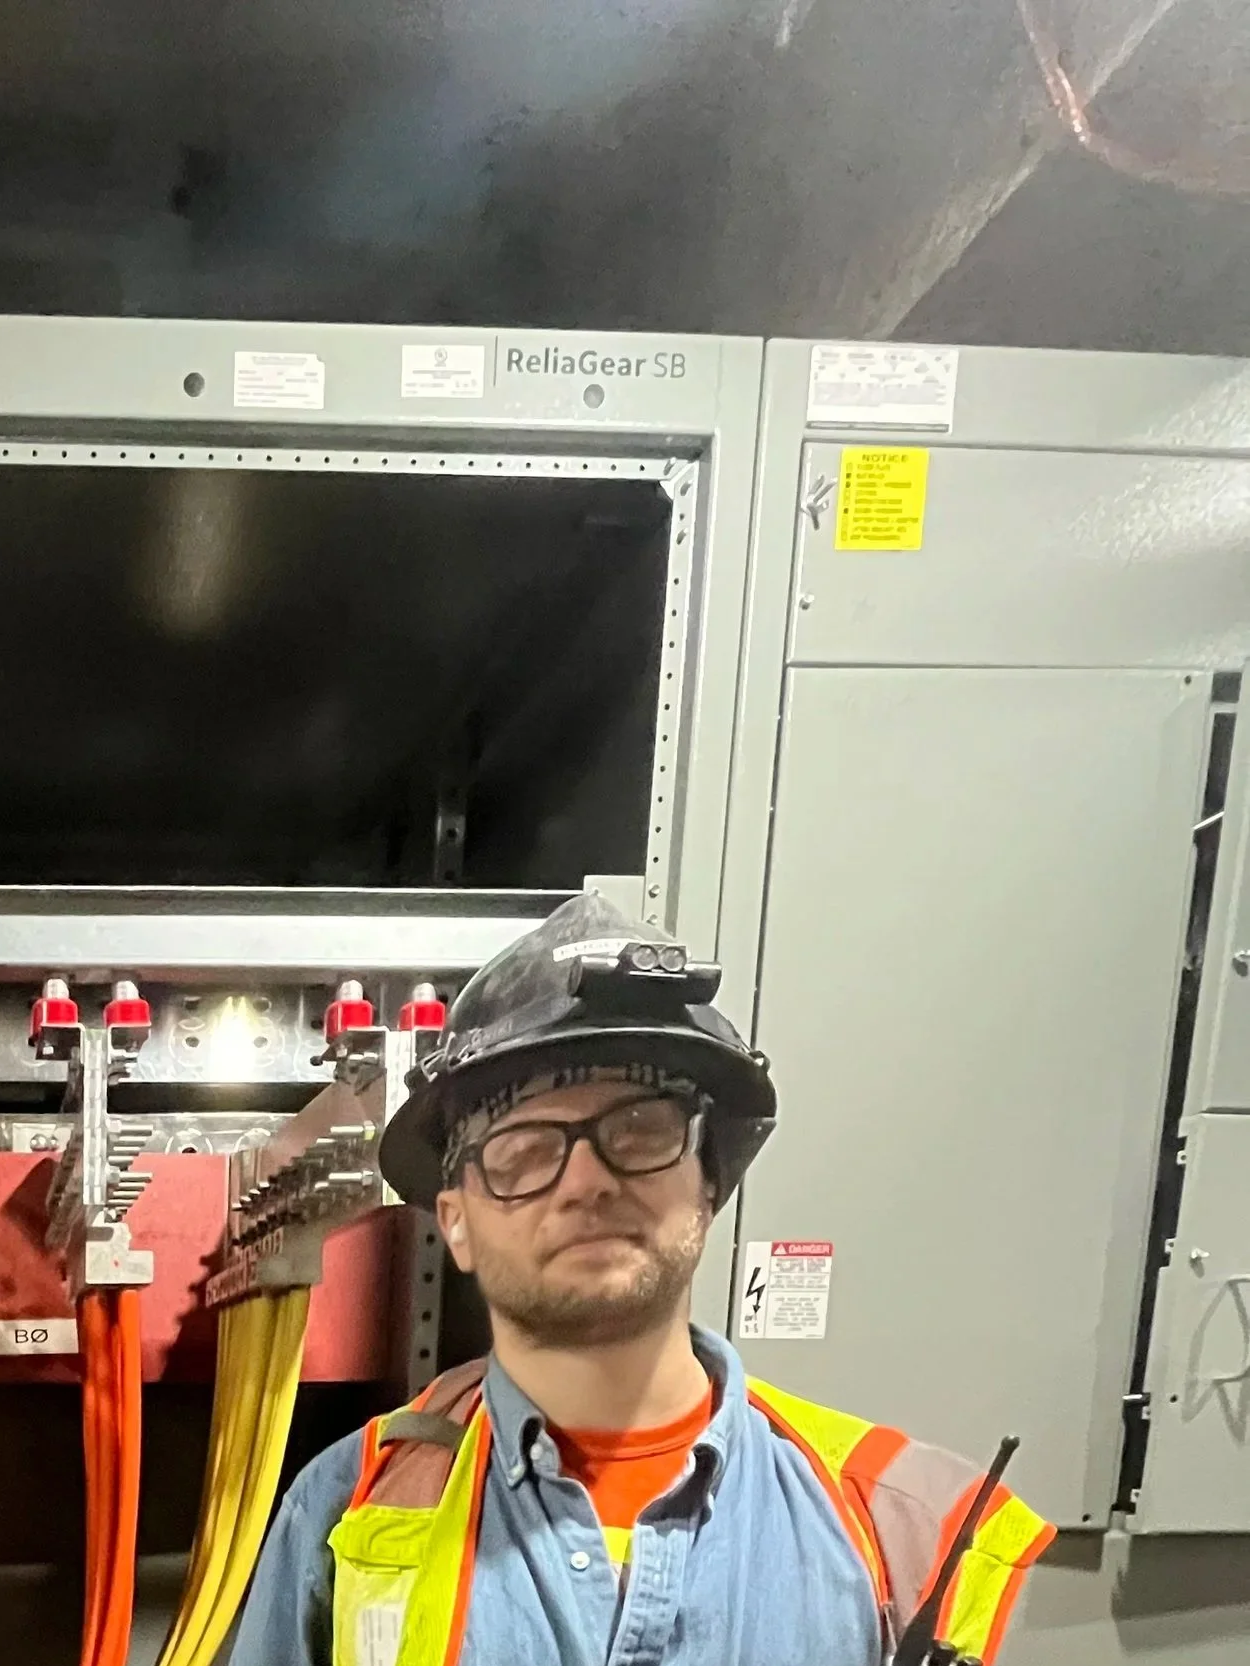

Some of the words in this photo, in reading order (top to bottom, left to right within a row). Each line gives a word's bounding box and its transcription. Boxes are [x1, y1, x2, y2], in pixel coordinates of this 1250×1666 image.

[507, 346, 647, 377] ReliaGear
[653, 352, 686, 378] SB
[862, 454, 908, 463] NOTICE
[788, 1244, 831, 1255] DANGER
